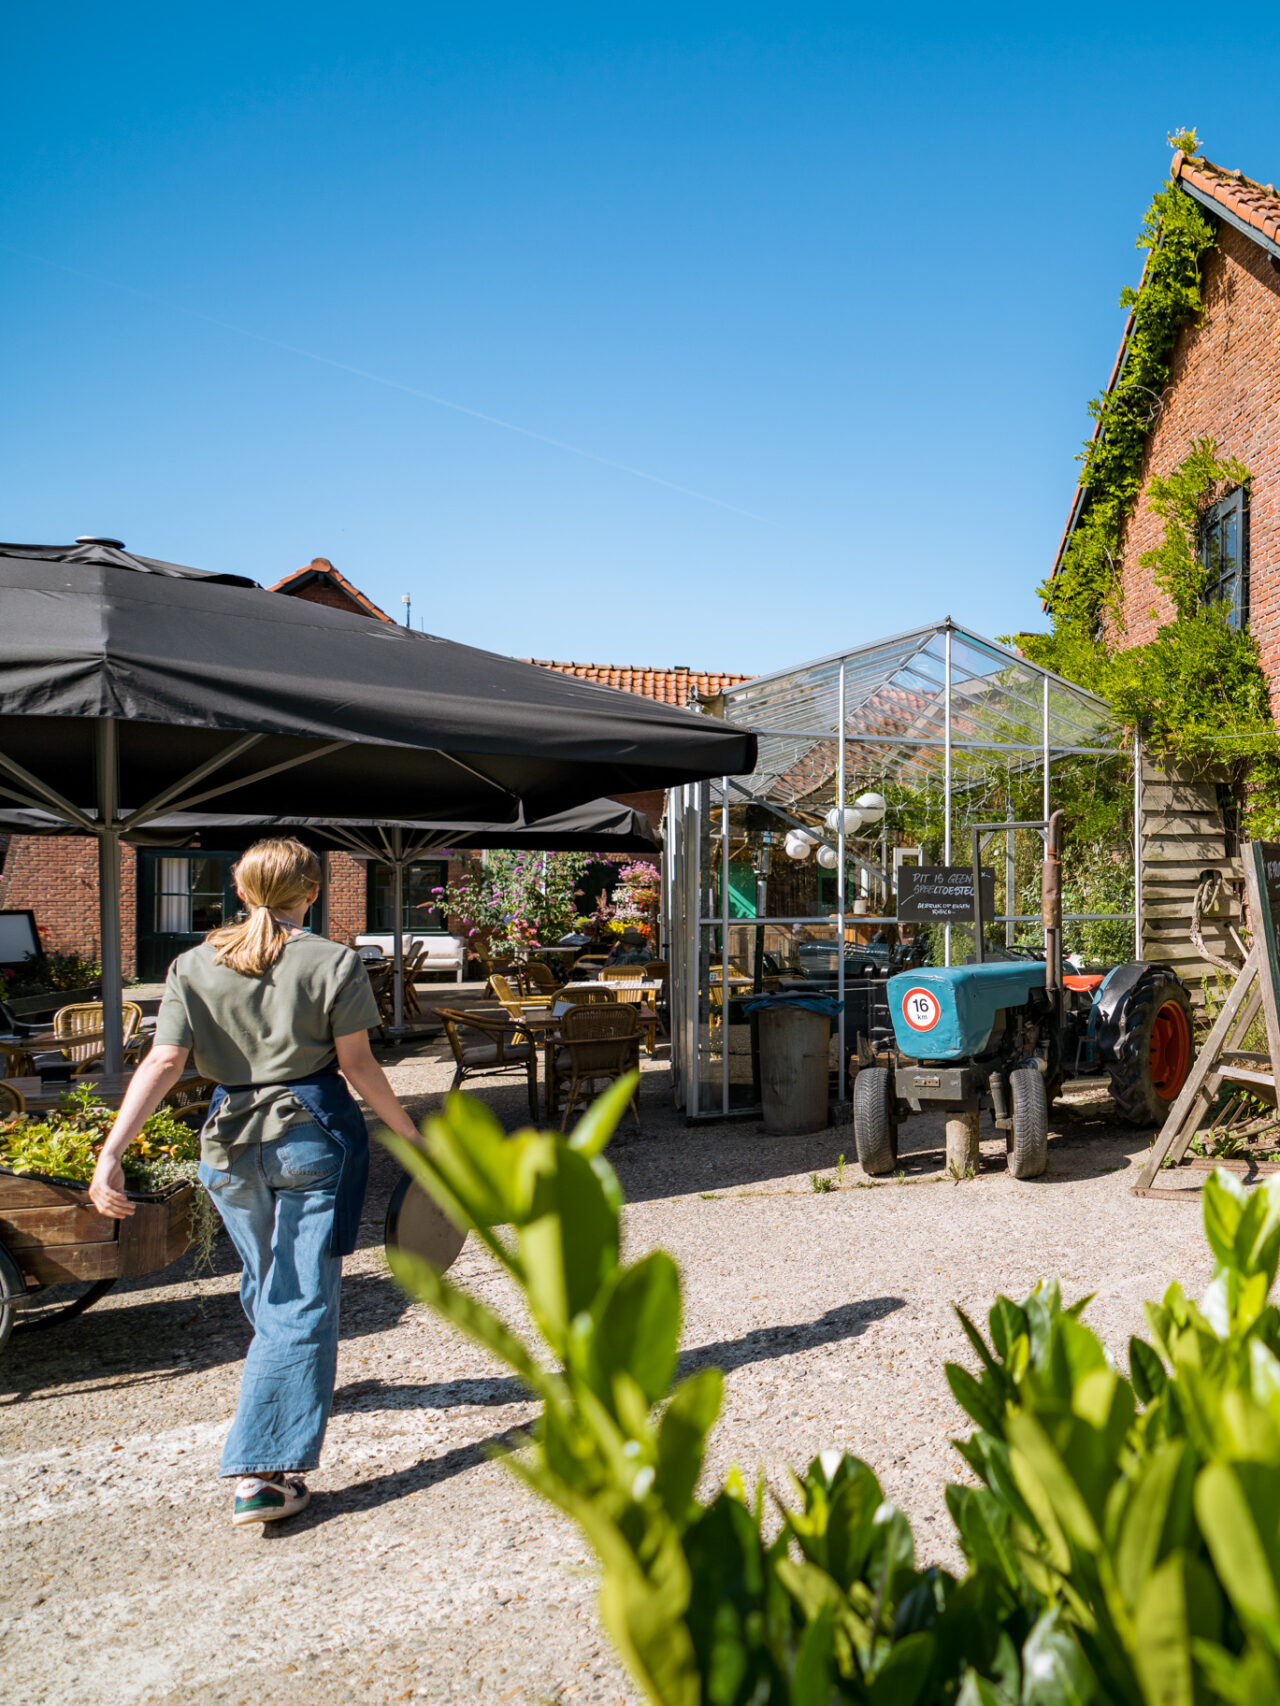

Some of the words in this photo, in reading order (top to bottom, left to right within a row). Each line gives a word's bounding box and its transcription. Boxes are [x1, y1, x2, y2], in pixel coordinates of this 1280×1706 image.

[912, 873, 931, 883] DIT
[934, 873, 944, 883] IS
[947, 873, 974, 884] GEEN
[912, 998, 929, 1012] 16
